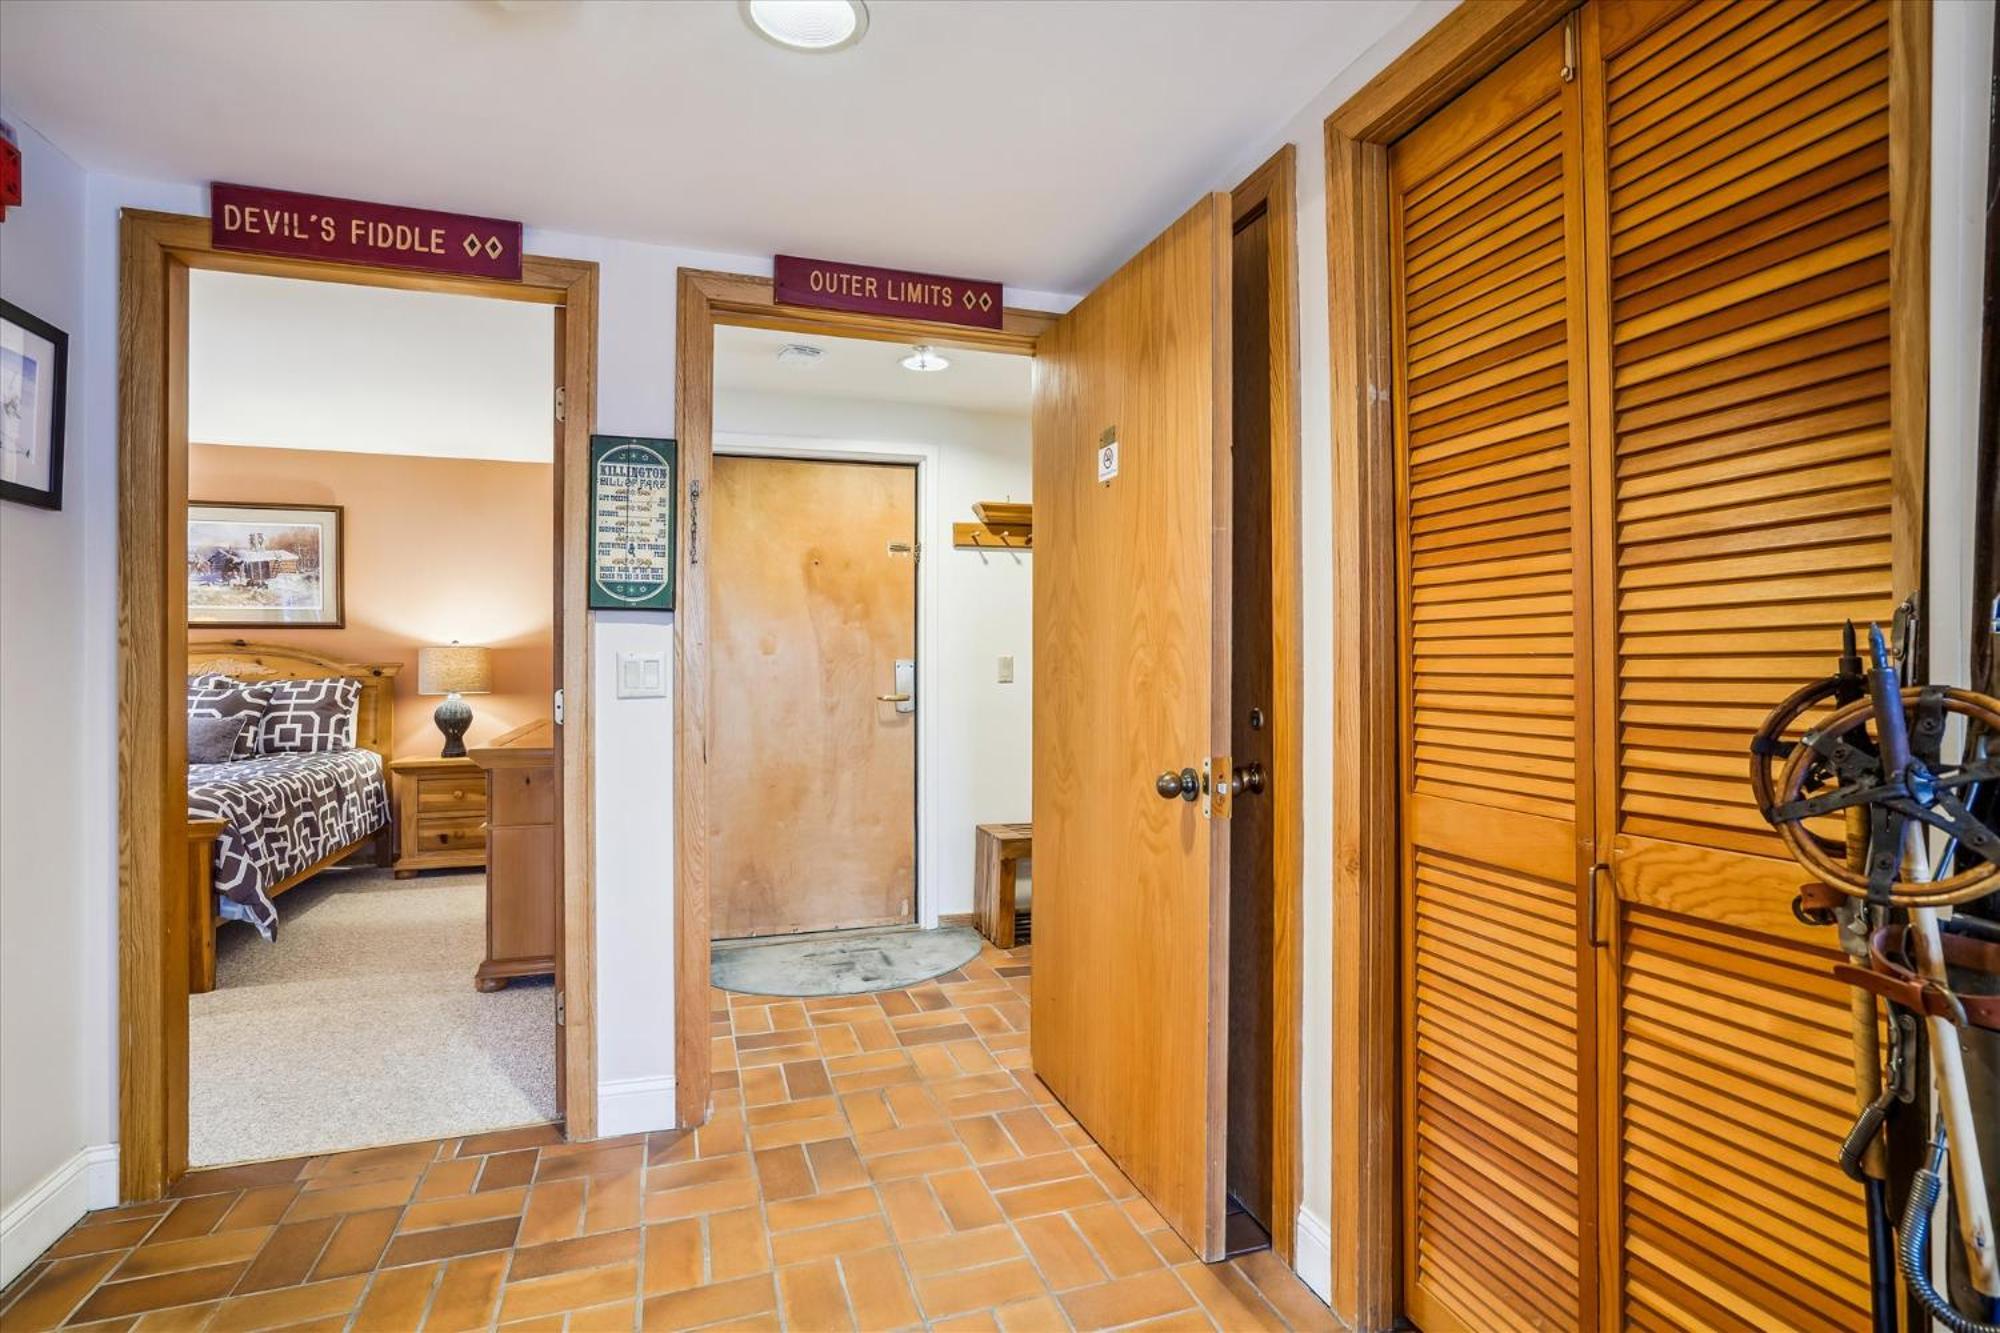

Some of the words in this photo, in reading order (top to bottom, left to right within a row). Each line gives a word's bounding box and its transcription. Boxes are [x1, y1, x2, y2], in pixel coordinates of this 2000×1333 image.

[223, 204, 336, 242] DEVIL'S
[351, 219, 446, 255] FIDDLE
[810, 270, 878, 298] OUTER
[887, 280, 953, 307] LIMITS
[600, 465, 667, 479] KILLINGTON
